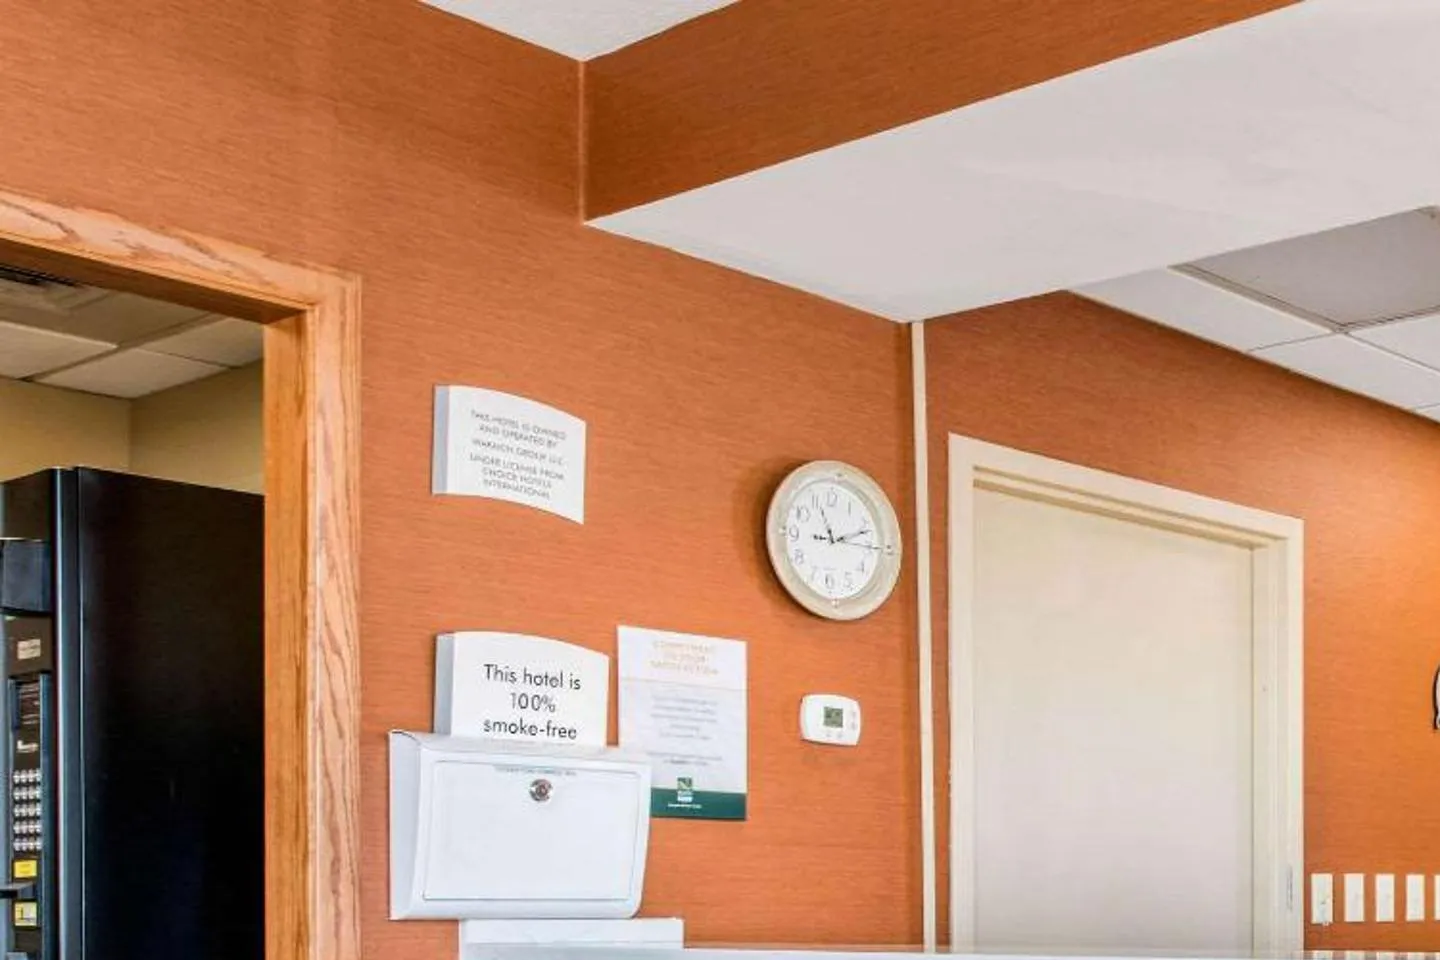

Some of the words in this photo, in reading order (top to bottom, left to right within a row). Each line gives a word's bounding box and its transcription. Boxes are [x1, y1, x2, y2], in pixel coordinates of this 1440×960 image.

[483, 663, 517, 684] This
[523, 666, 564, 688] hotel
[569, 672, 581, 690] is
[511, 691, 556, 713] 100%
[483, 717, 578, 740] smoke-free
